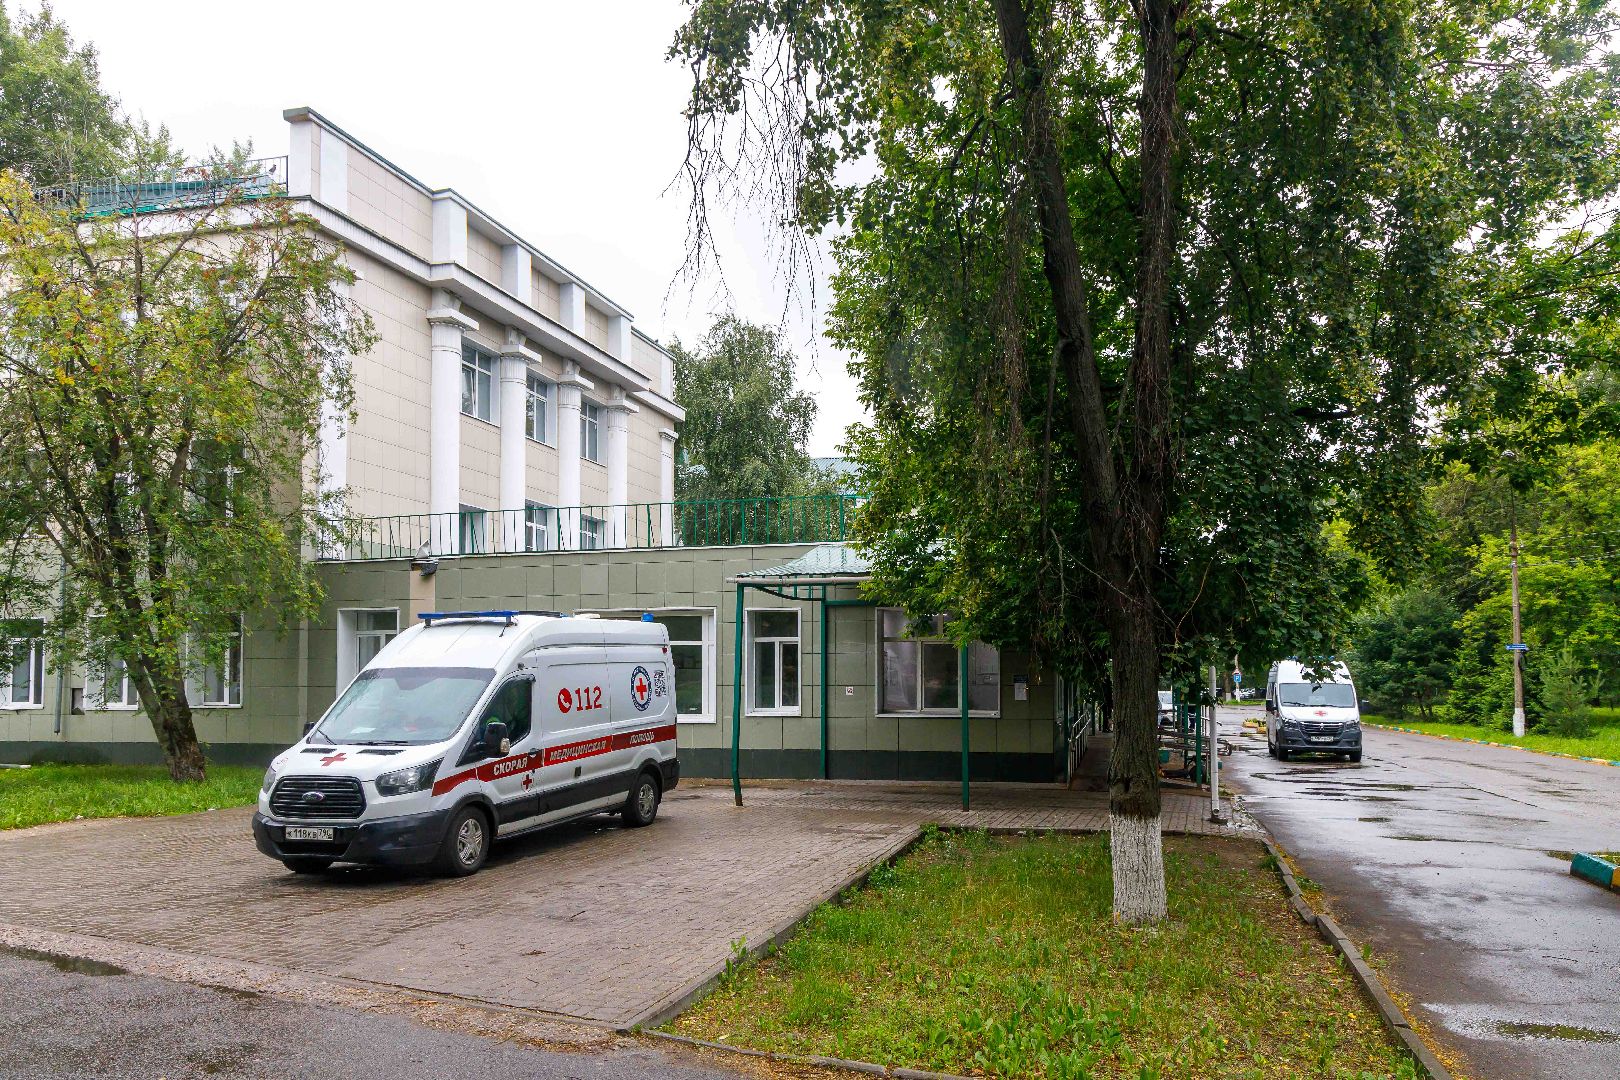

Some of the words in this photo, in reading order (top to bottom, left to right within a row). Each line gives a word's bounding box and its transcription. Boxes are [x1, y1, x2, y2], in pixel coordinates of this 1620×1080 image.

[575, 686, 602, 711] 112
[493, 757, 528, 775] СКОРАЯ
[549, 741, 606, 761] МЕДИЦИНСКАЯ
